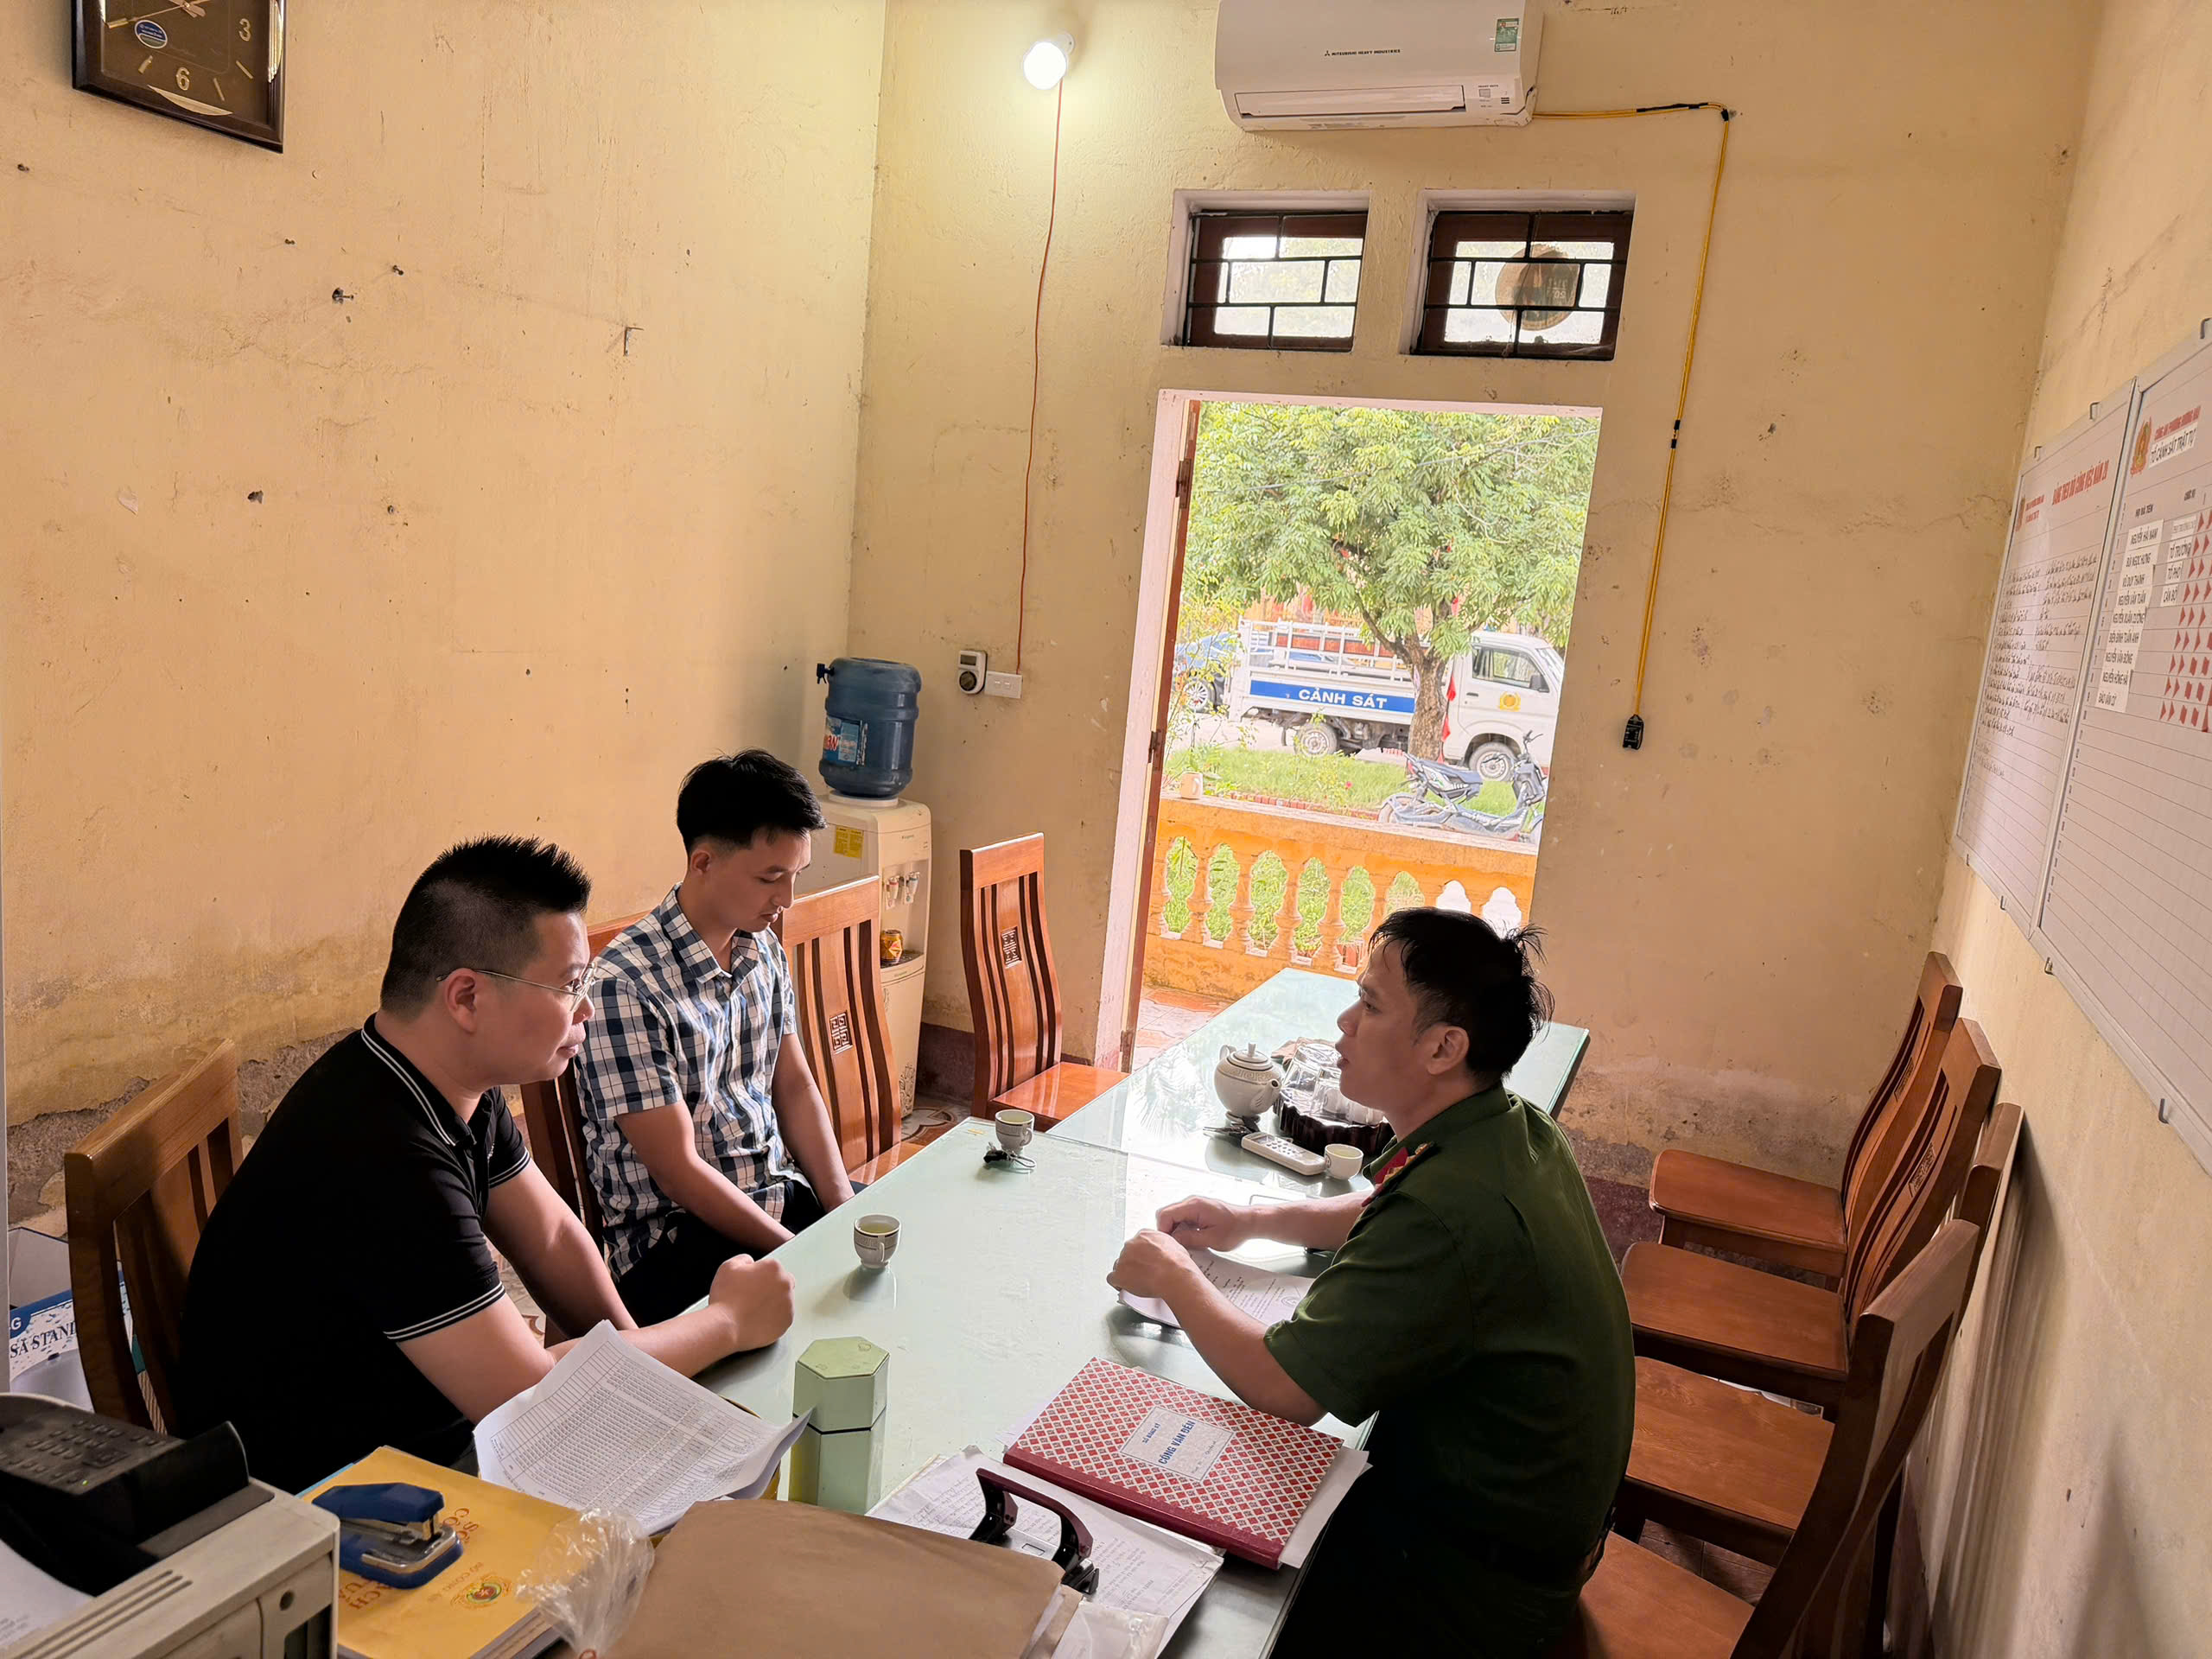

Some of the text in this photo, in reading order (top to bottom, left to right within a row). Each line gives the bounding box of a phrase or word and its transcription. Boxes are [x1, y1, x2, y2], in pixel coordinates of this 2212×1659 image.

[238, 17, 251, 41] 3
[175, 67, 191, 91] 6
[1299, 687, 1388, 709] CẢNH SÁT
[1158, 1421, 1197, 1465] CÔNG VĂN ĐẾN
